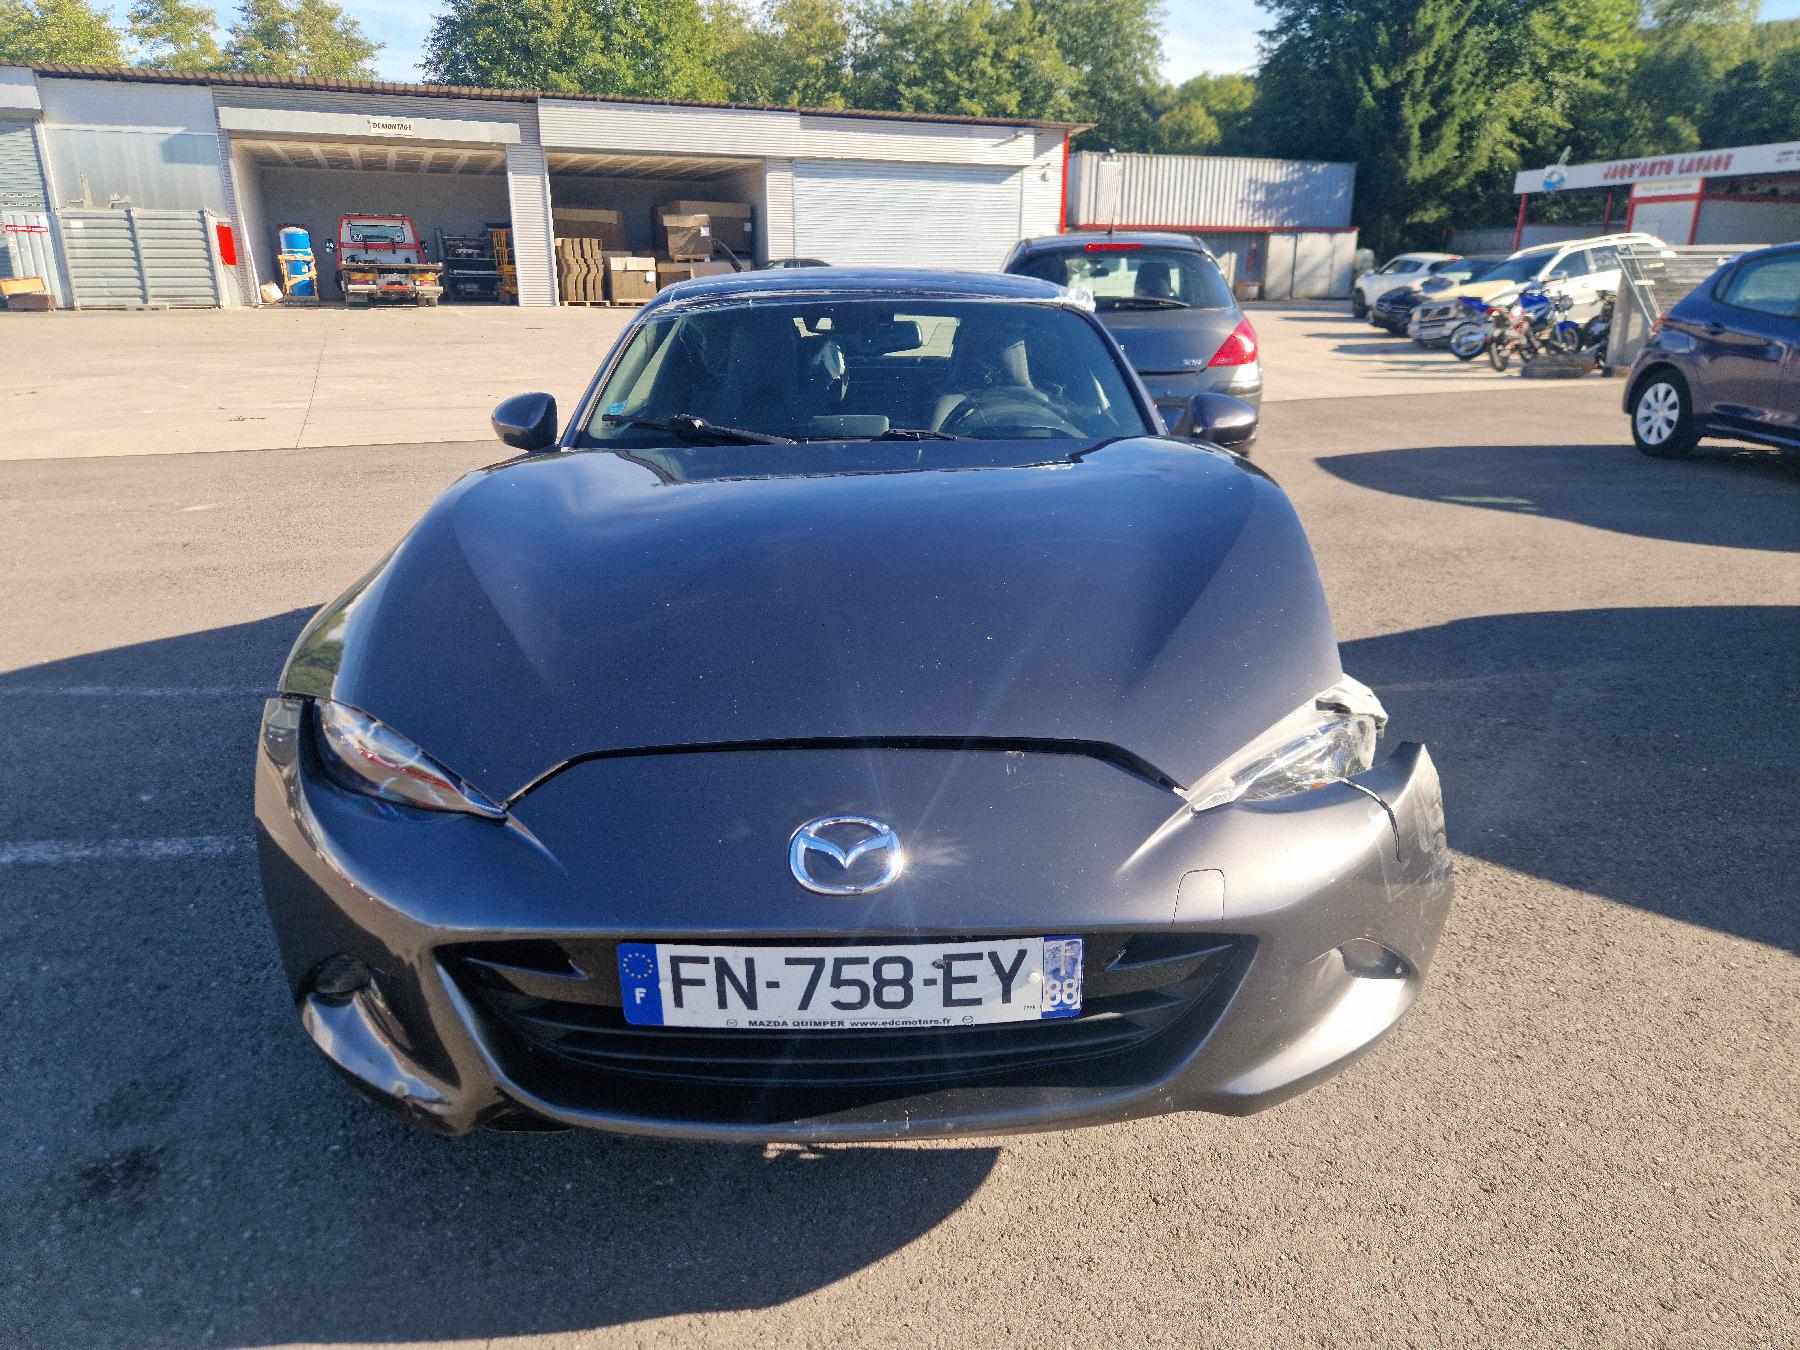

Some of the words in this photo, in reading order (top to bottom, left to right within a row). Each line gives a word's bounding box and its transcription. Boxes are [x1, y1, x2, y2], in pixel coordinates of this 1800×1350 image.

[1678, 152, 1734, 176] LAVAGE
[669, 949, 1028, 1012] FN-758-EY
[1045, 978, 1079, 1006] 88
[635, 987, 647, 1005] F
[792, 1020, 845, 1028] QUIMPER
[850, 1017, 951, 1027] www.edcmotors.fr
